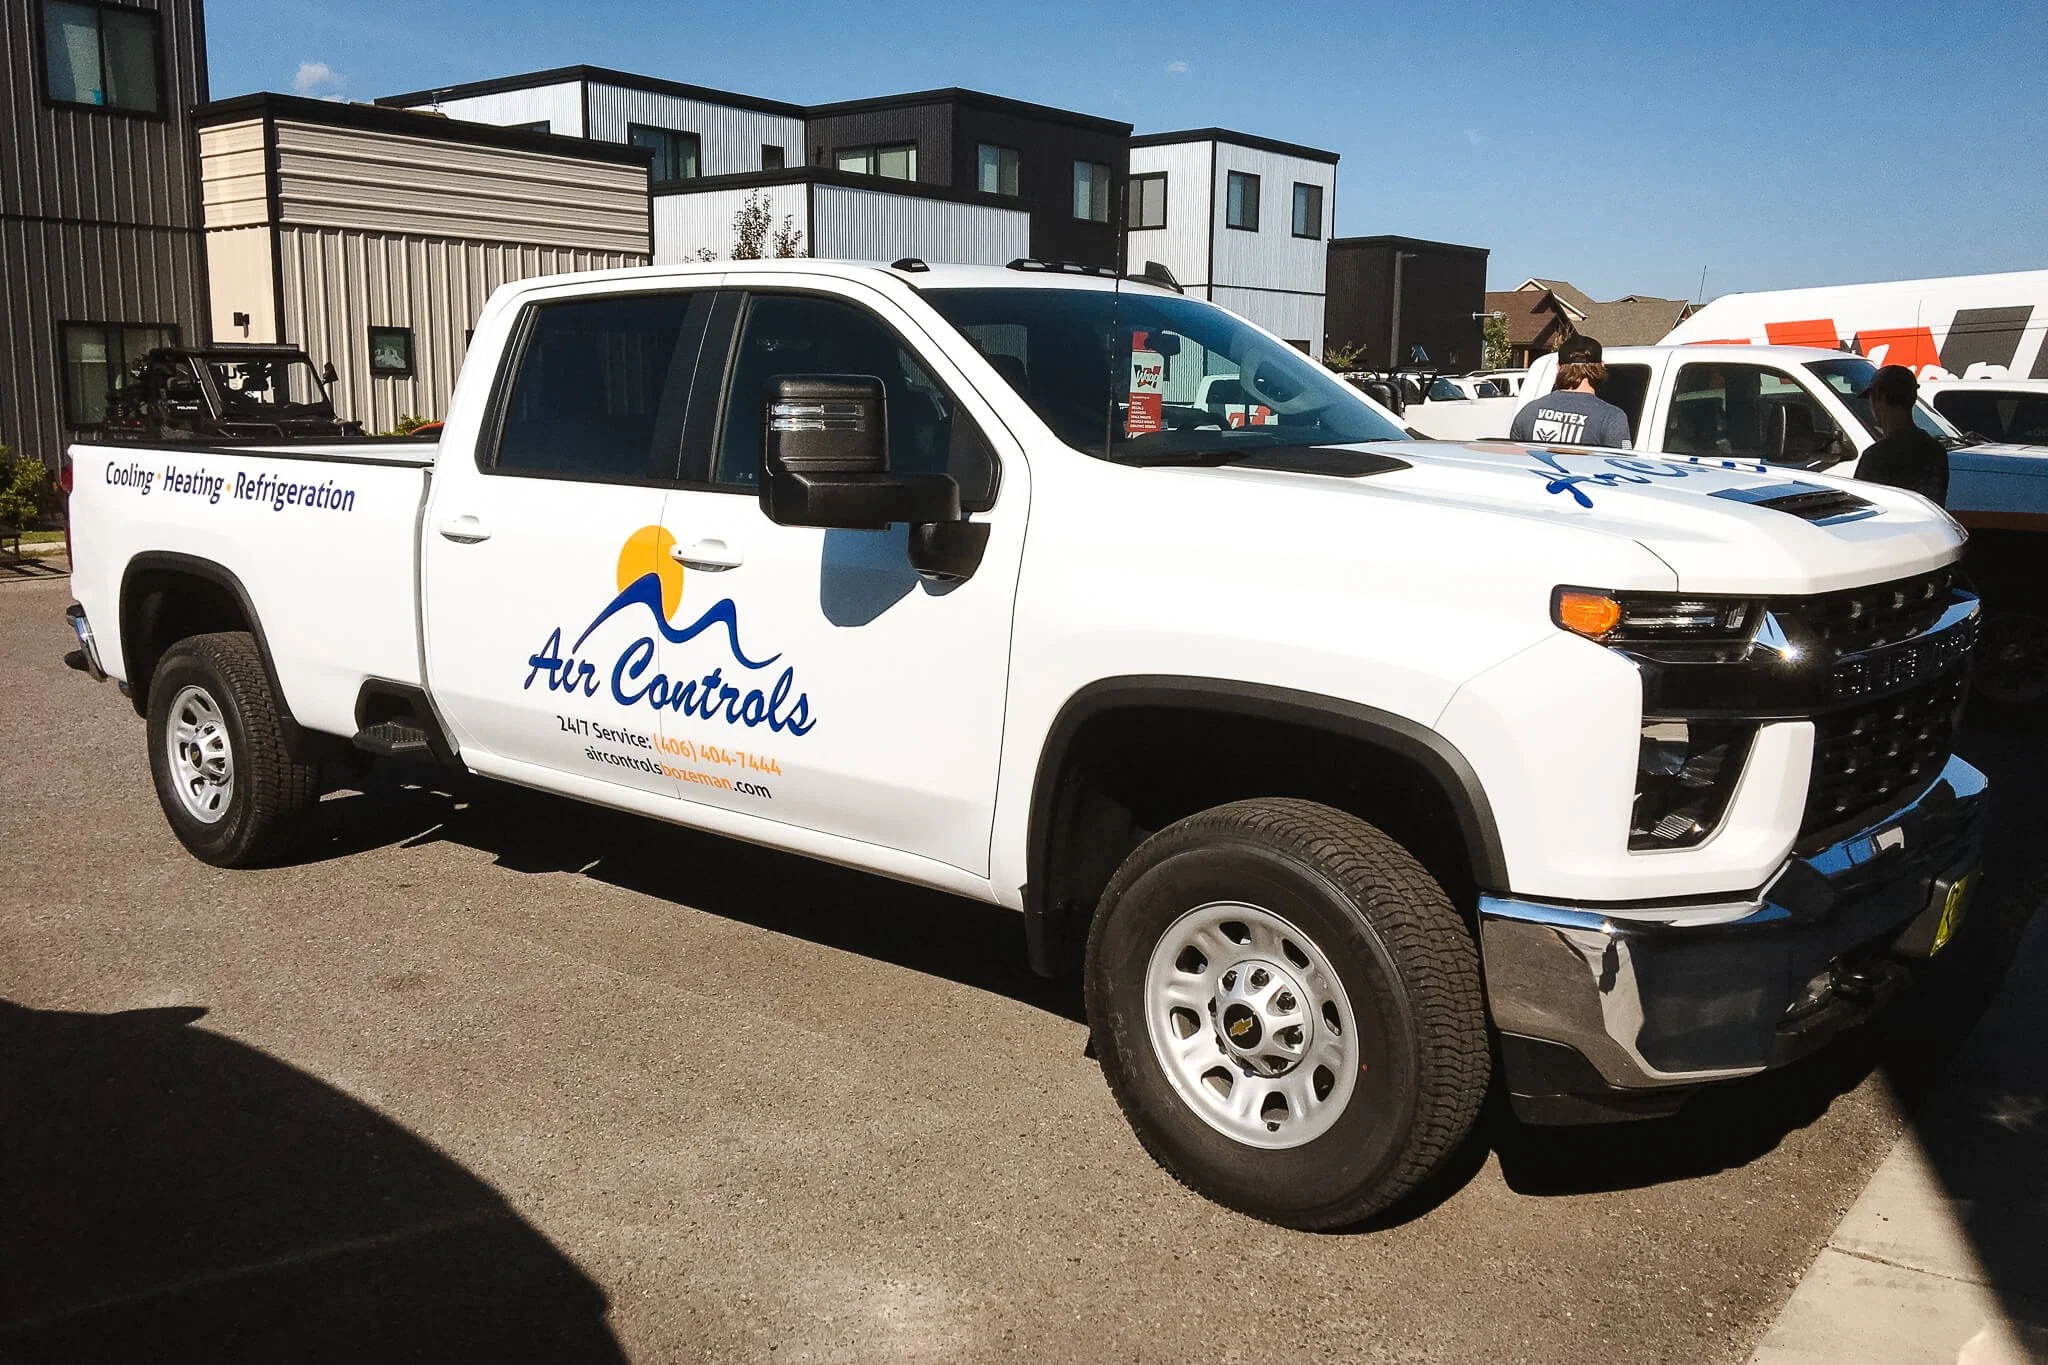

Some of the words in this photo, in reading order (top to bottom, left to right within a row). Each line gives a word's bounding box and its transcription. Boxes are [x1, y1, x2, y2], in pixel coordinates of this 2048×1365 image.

[1538, 408, 1588, 426] VORTEX
[105, 461, 154, 495] Cooling
[163, 465, 224, 504] Heating
[233, 471, 355, 512] Refrigeration
[523, 626, 600, 698] Air
[611, 636, 817, 736] Controls
[556, 715, 589, 736] 24/7
[595, 724, 652, 749] Service:
[653, 732, 697, 762] (406)
[700, 741, 782, 776] 404-7444
[585, 747, 771, 799] aircontrolsbozeman.com
